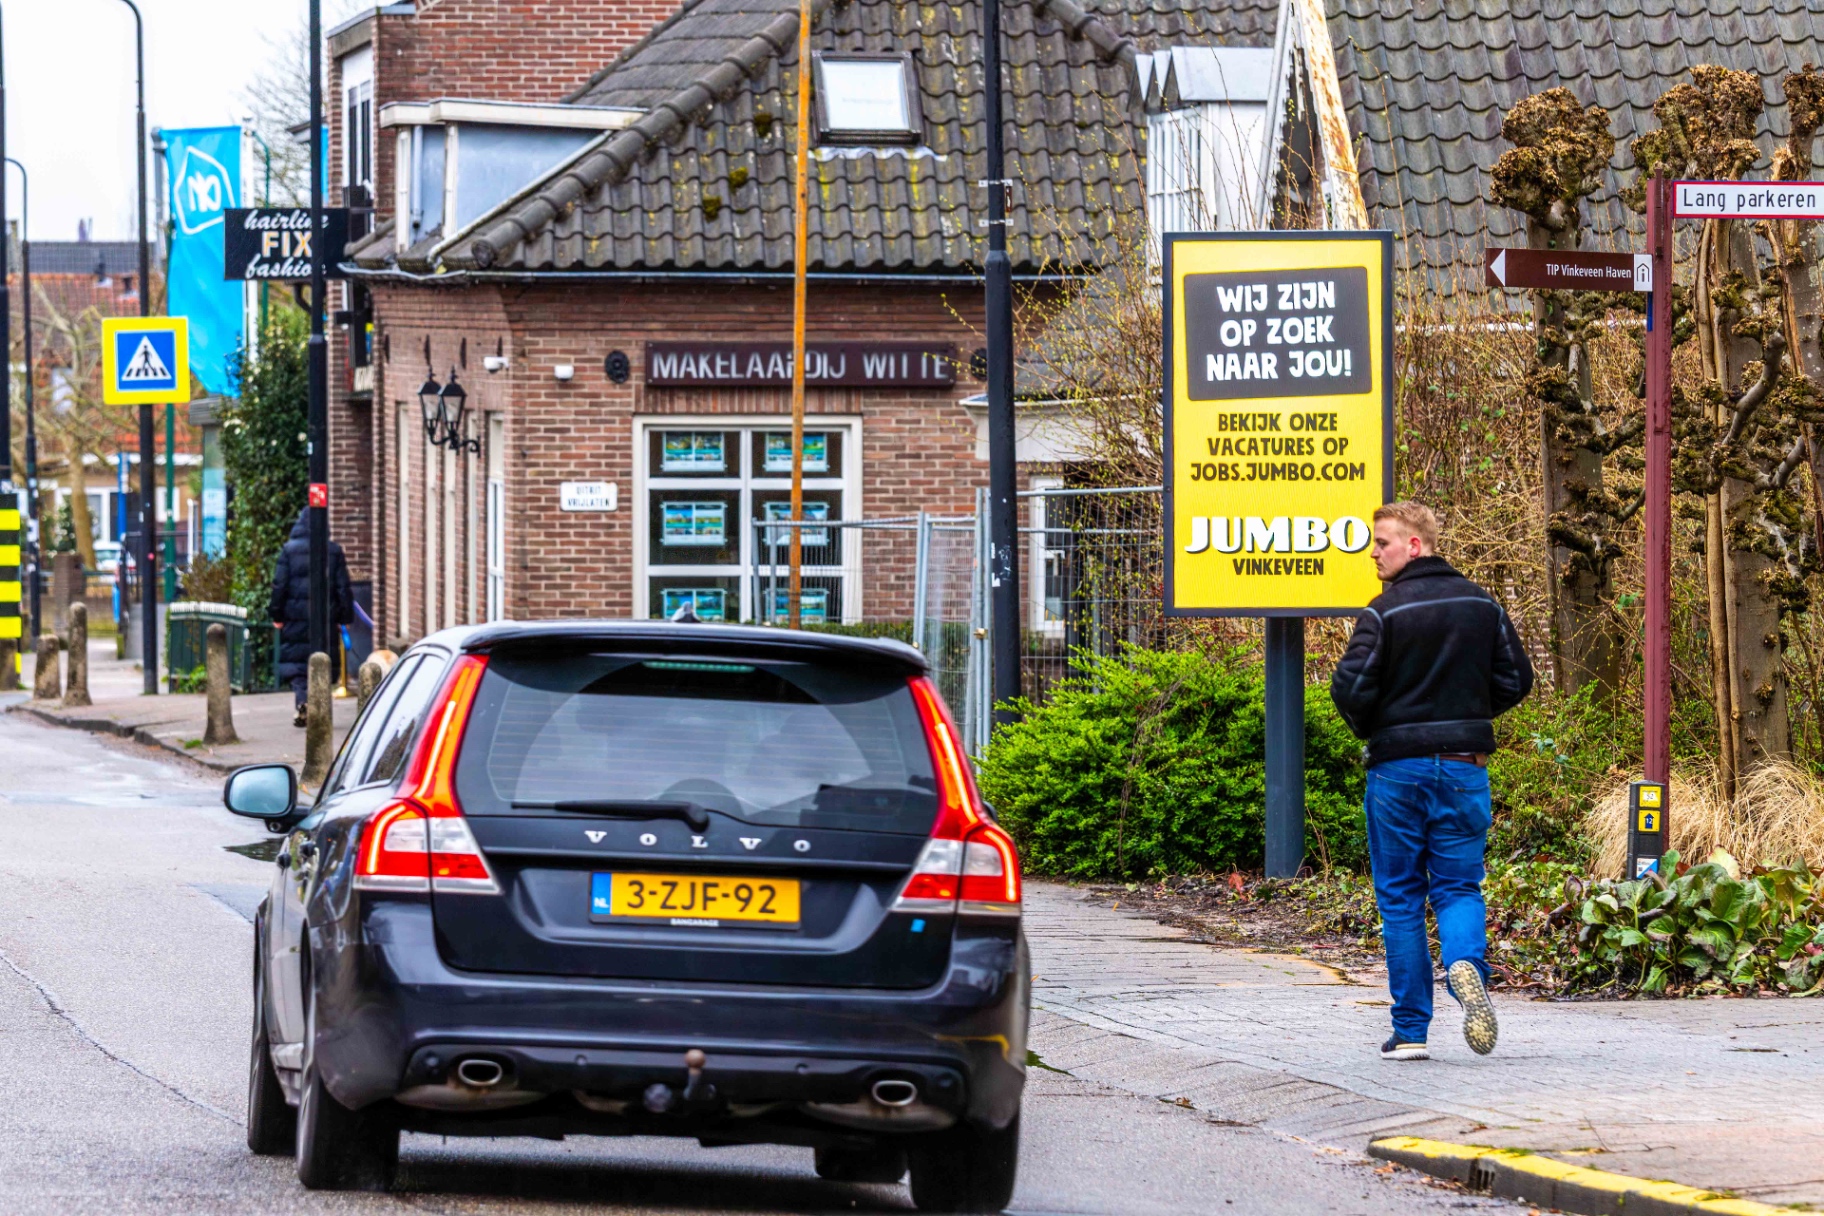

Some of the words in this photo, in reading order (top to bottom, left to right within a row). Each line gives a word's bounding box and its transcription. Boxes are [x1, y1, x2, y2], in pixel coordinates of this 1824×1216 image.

[1683, 188, 1725, 212] Lang
[1736, 189, 1816, 212] parkeren
[244, 209, 329, 230] hairlie
[262, 231, 312, 257] FIX
[245, 253, 327, 279] fashio
[1546, 263, 1559, 276] TIP
[1560, 264, 1604, 278] Vinkeveen
[1605, 265, 1632, 279] Haven
[1216, 283, 1268, 312] WIJ
[1277, 281, 1336, 310] ZIJN
[1219, 319, 1257, 347] OP
[1266, 315, 1335, 345] ZOEK
[1206, 352, 1279, 382] NAAR
[1288, 348, 1352, 378] JOU!
[1218, 413, 1281, 432] BEKIJK
[1289, 412, 1338, 432] ONZE
[1207, 437, 1315, 456] VACATURES
[1322, 436, 1349, 456] OP
[1190, 462, 1365, 482] JOBS.JUMBO.COM
[568, 498, 610, 507] VRIJLATEN
[1184, 515, 1372, 553] JUMBO
[1232, 557, 1324, 576] VINKEVEEN
[584, 830, 811, 852] VOLVO
[594, 897, 609, 909] NL
[627, 880, 776, 914] 3-ZJF-92
